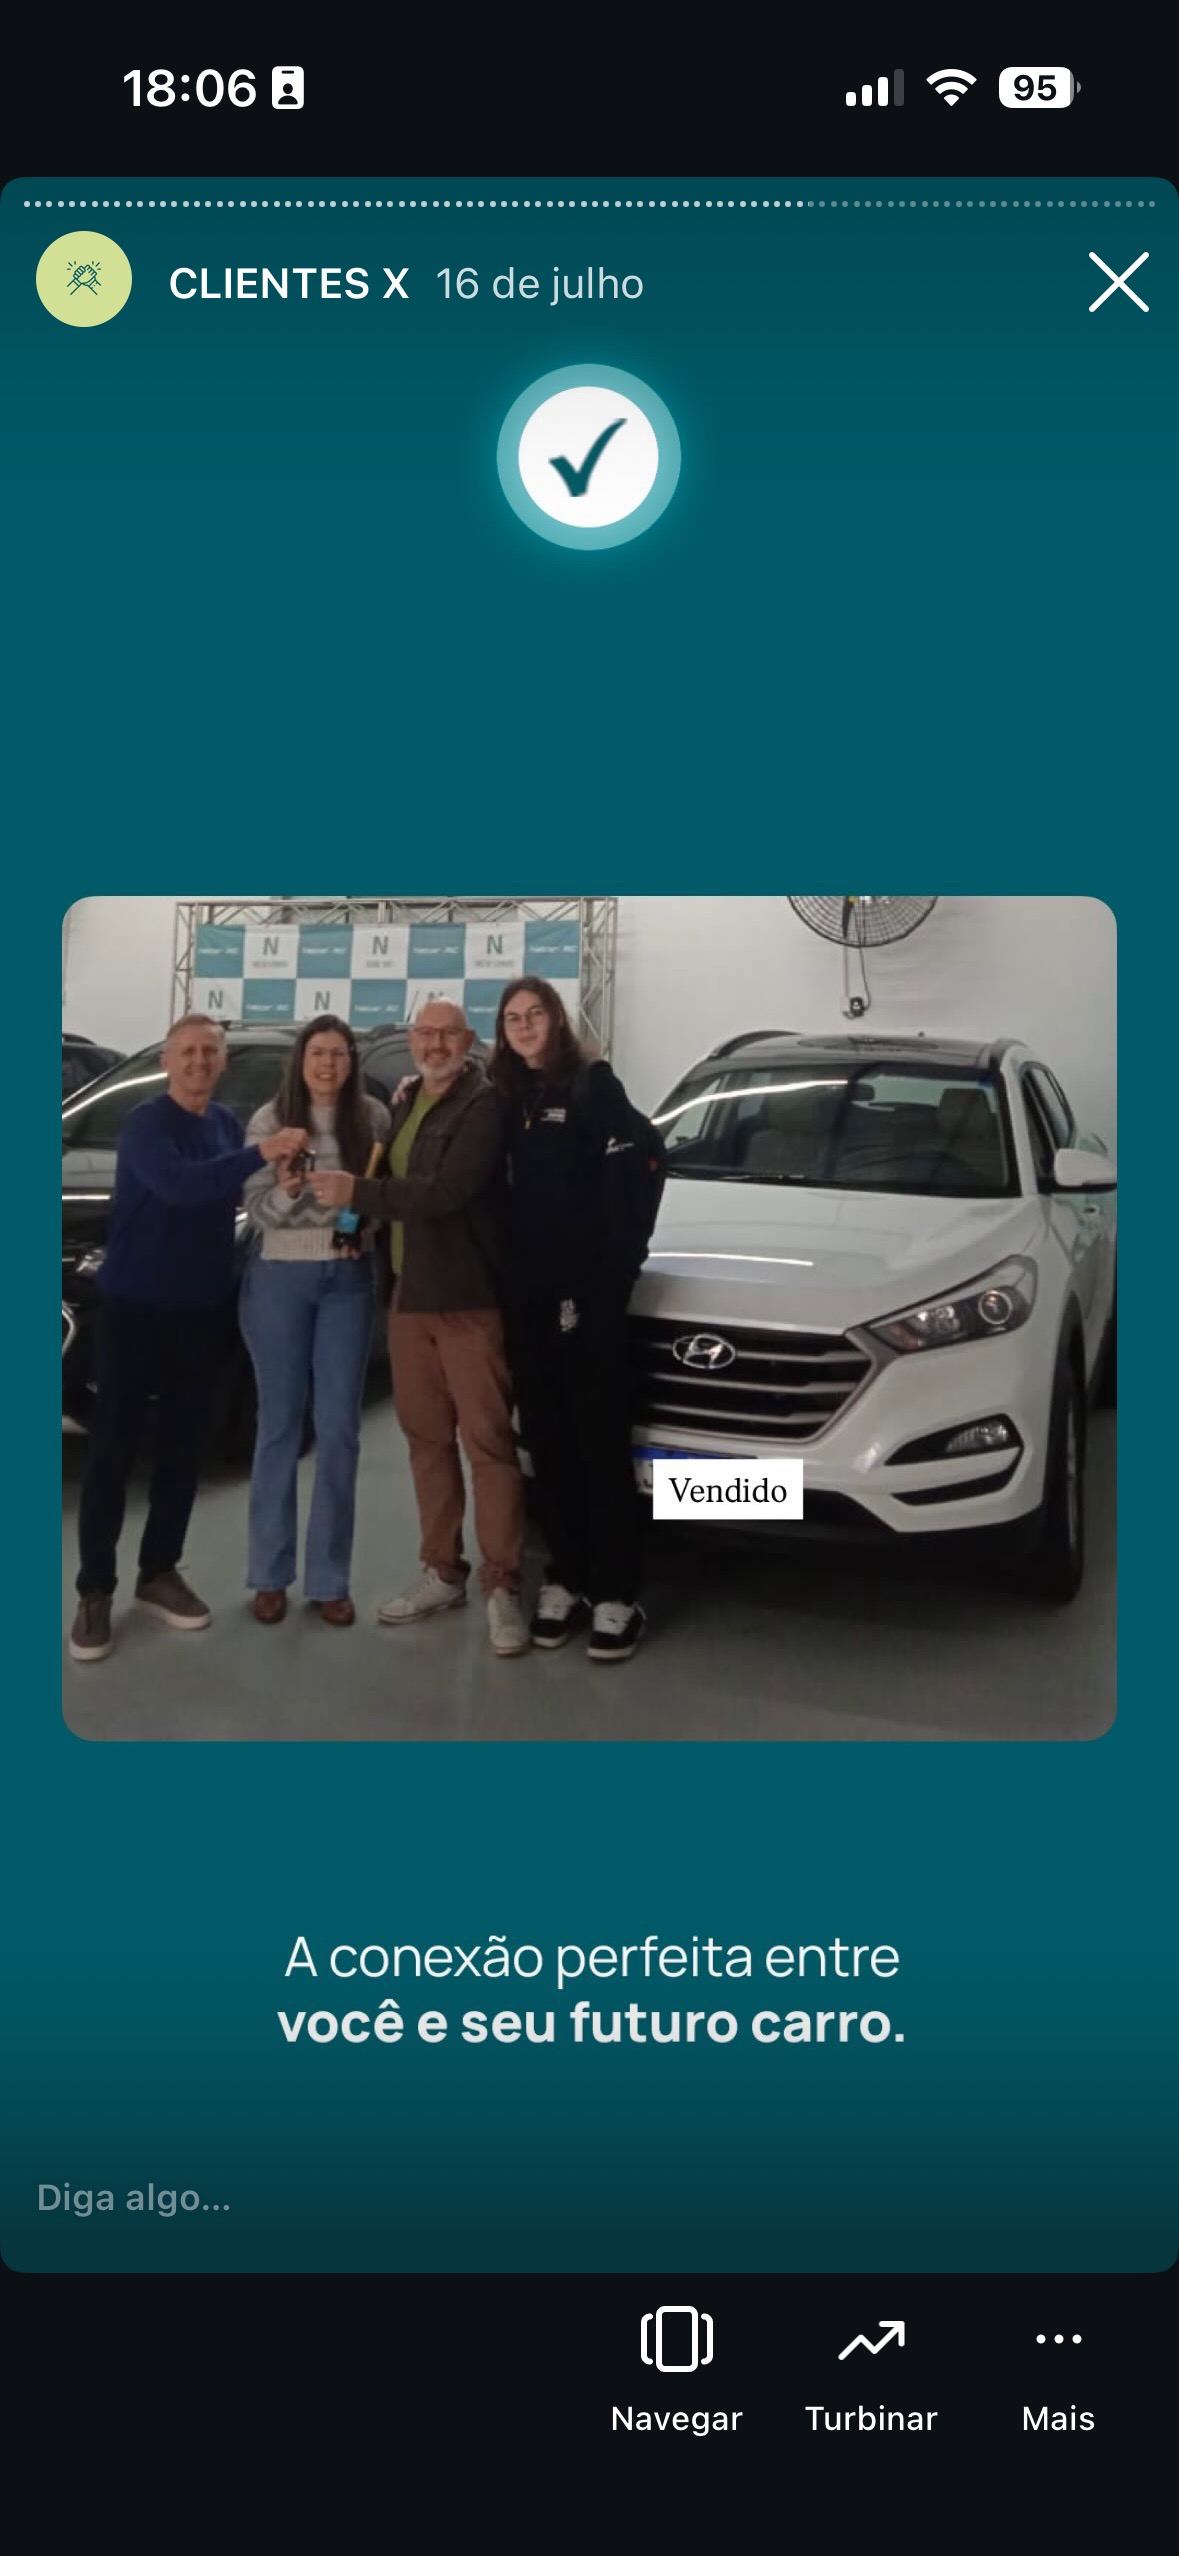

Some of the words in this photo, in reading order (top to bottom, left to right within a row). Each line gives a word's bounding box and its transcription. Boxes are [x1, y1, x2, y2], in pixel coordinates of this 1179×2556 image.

[263, 936, 280, 956] N
[372, 936, 390, 956] N
[486, 935, 504, 955] N
[208, 990, 224, 1010] N
[315, 991, 331, 1011] N
